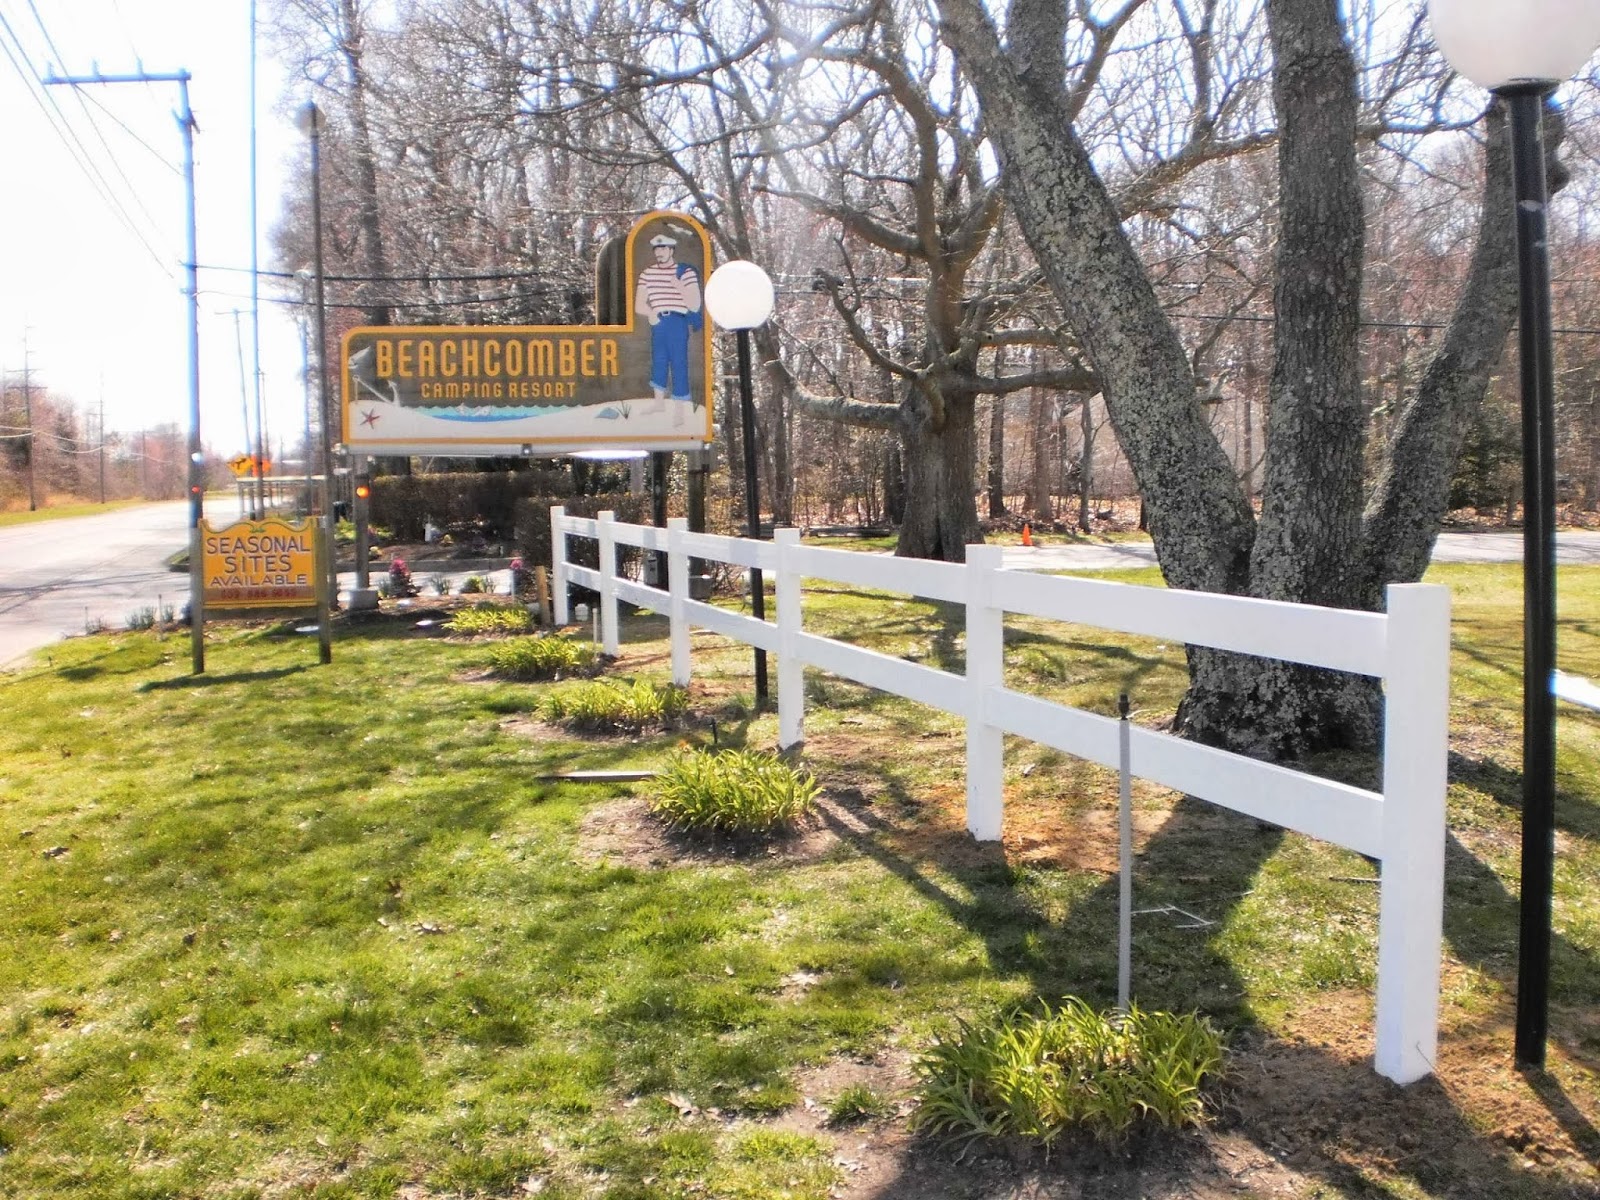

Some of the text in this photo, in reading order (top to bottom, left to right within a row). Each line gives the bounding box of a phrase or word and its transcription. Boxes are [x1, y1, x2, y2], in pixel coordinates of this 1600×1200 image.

[376, 339, 619, 377] BEACHCOMBER
[421, 382, 576, 398] CAMPING RESORT
[206, 536, 311, 554] SEASONAL
[224, 555, 292, 573] SITES
[210, 574, 307, 586] AVAILABLE
